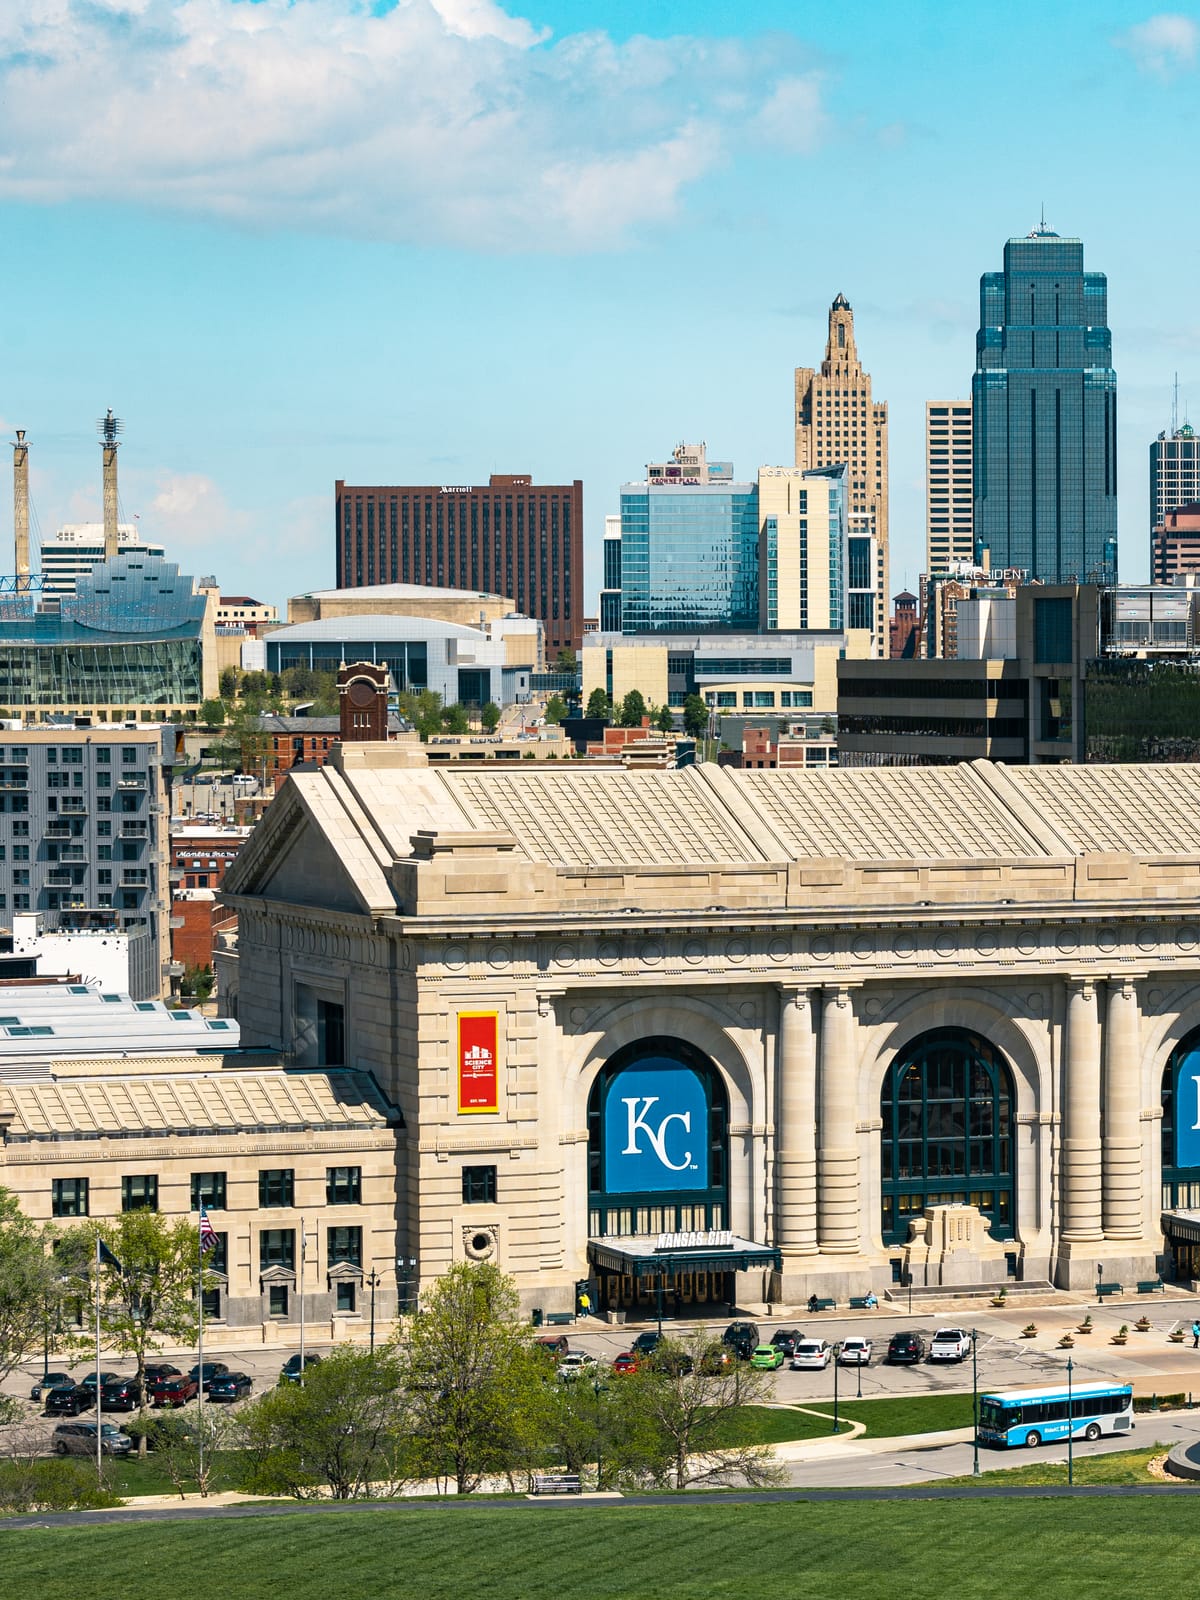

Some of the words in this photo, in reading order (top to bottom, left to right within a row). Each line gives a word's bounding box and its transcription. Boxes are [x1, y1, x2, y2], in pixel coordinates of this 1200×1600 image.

[955, 569, 1030, 580] PRESIDENT
[621, 1096, 692, 1171] KC
[657, 1231, 704, 1249] KANSAS
[707, 1230, 734, 1246] CITY
